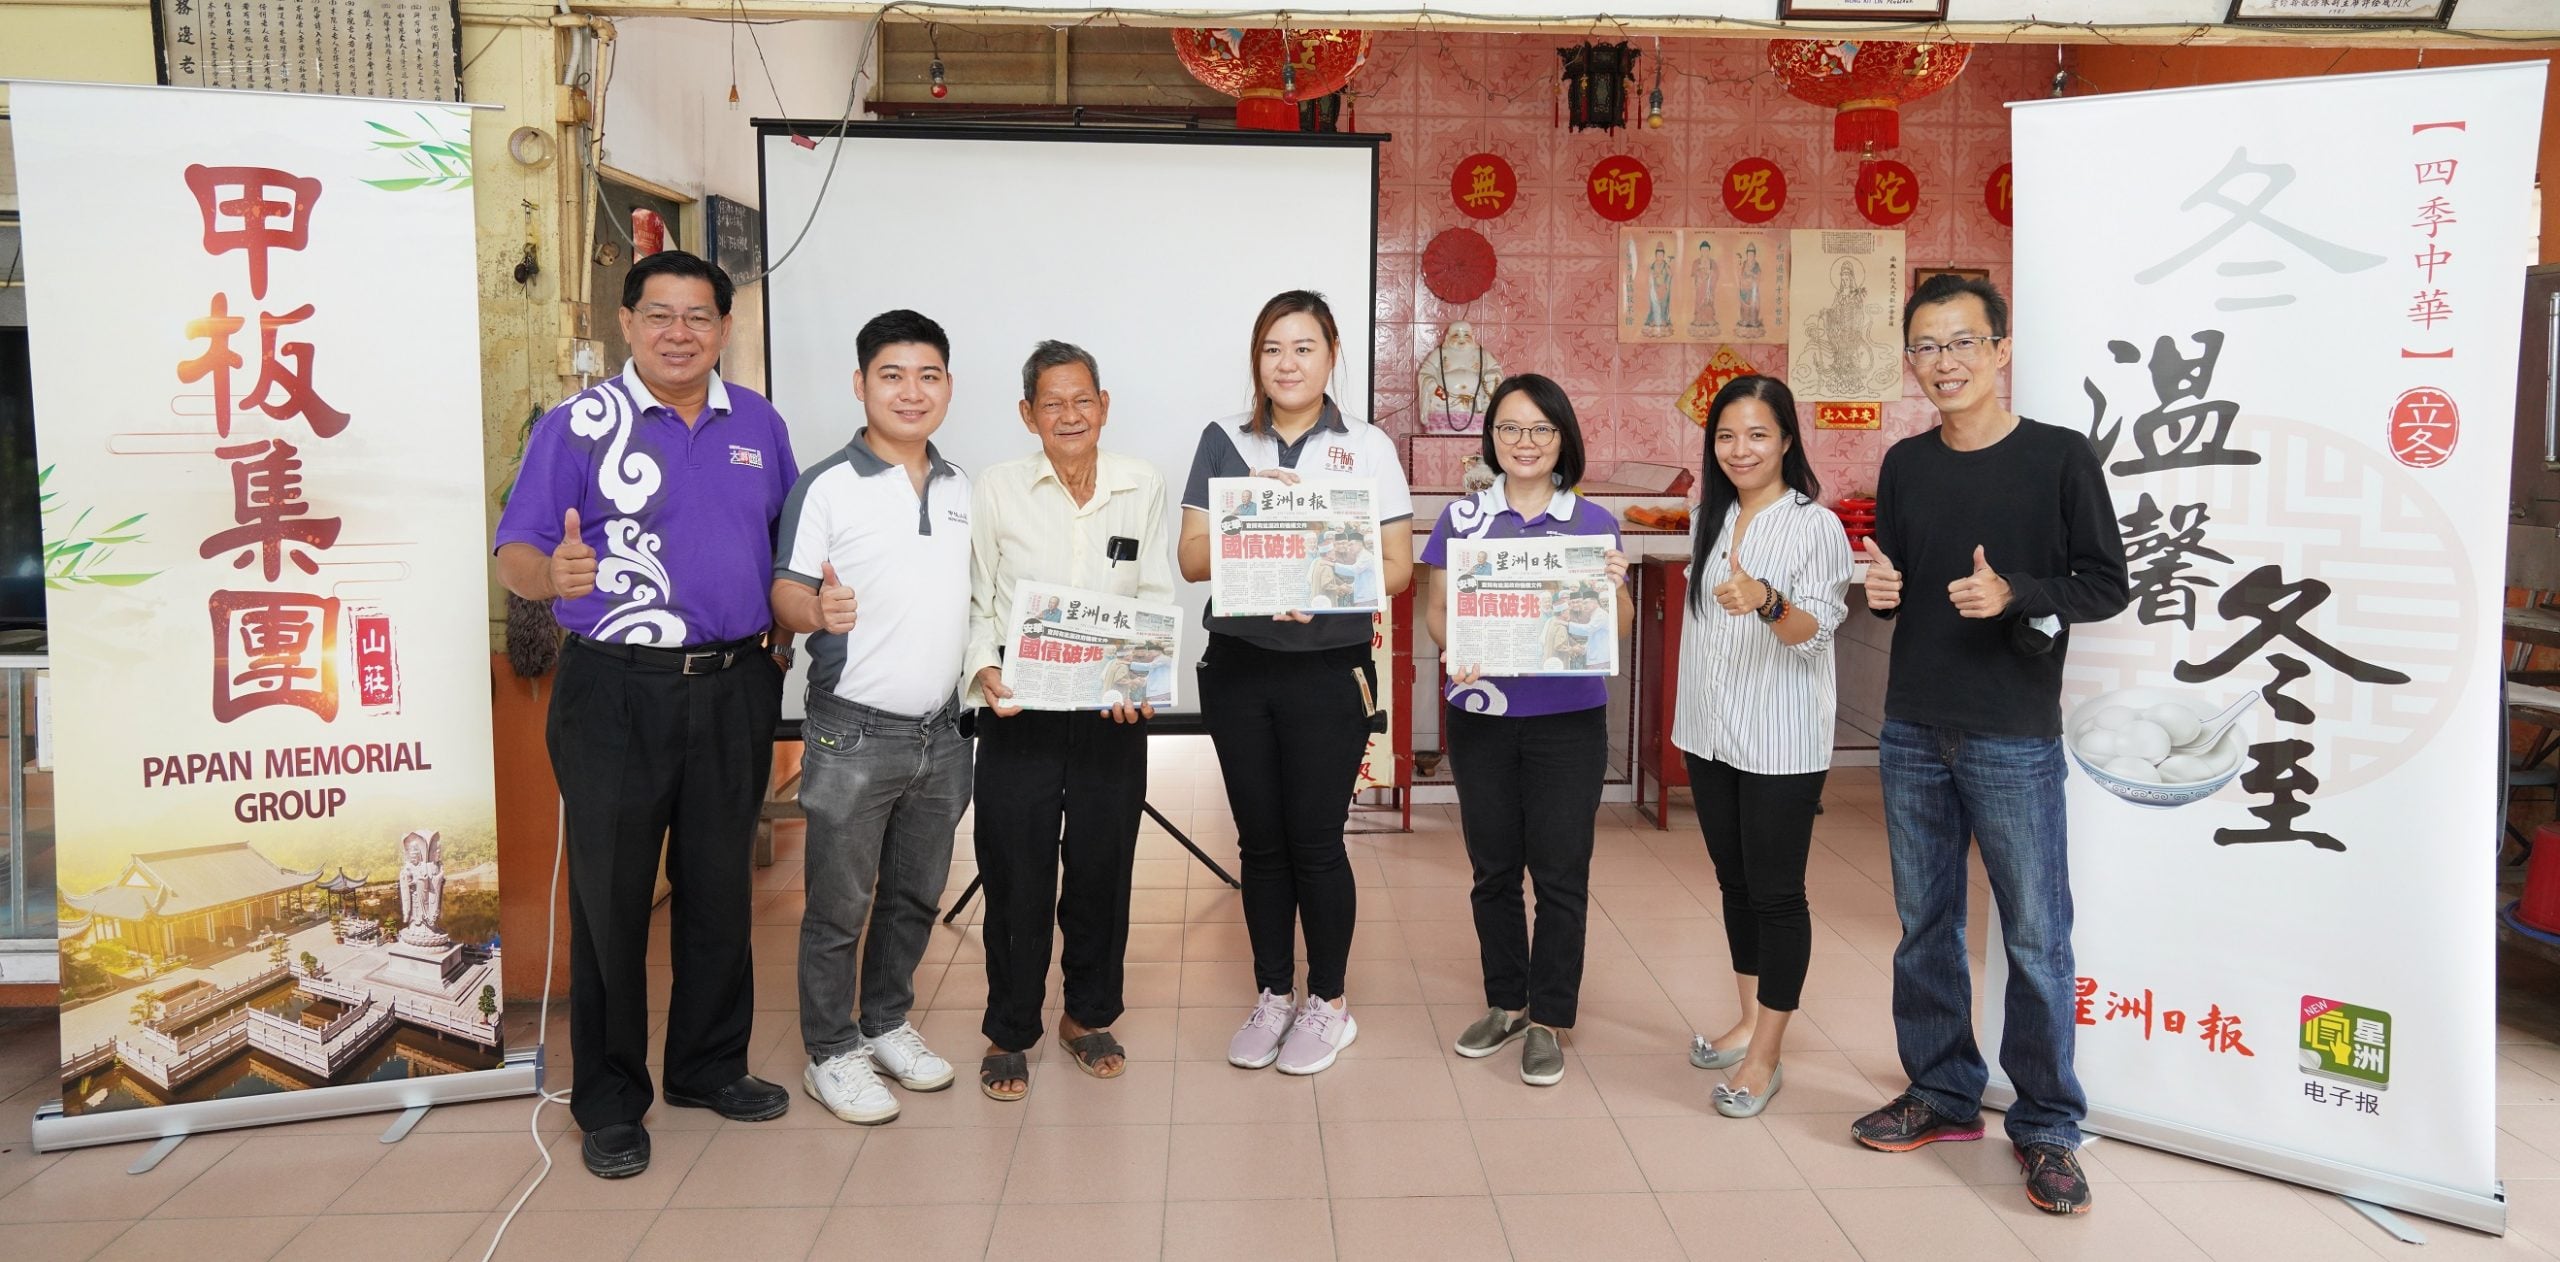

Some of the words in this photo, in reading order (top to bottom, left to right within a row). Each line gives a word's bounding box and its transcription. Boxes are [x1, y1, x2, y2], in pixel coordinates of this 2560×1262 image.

[2133, 145, 2388, 311] 冬
[1823, 408, 1873, 422] 出入平安
[2399, 396, 2450, 463] 立冬
[177, 163, 351, 724] 甲板集團
[1261, 490, 1328, 511] 星洲日報
[1221, 533, 1306, 560] 國債破兆
[1495, 551, 1563, 571] 星洲日報
[1066, 600, 1131, 630] 星洲日報
[1456, 592, 1541, 619] 國債破兆
[362, 628, 389, 694] 山莊
[1018, 636, 1104, 664] 國債破兆
[143, 751, 253, 788] PAPAN
[265, 741, 432, 779] MEMORIAL
[234, 787, 347, 824] GROUP
[2073, 976, 2255, 1057] 星洲日報
[2304, 1000, 2328, 1016] NEW
[2353, 1017, 2386, 1074] 星洲
[2304, 1081, 2380, 1116] 电子报
